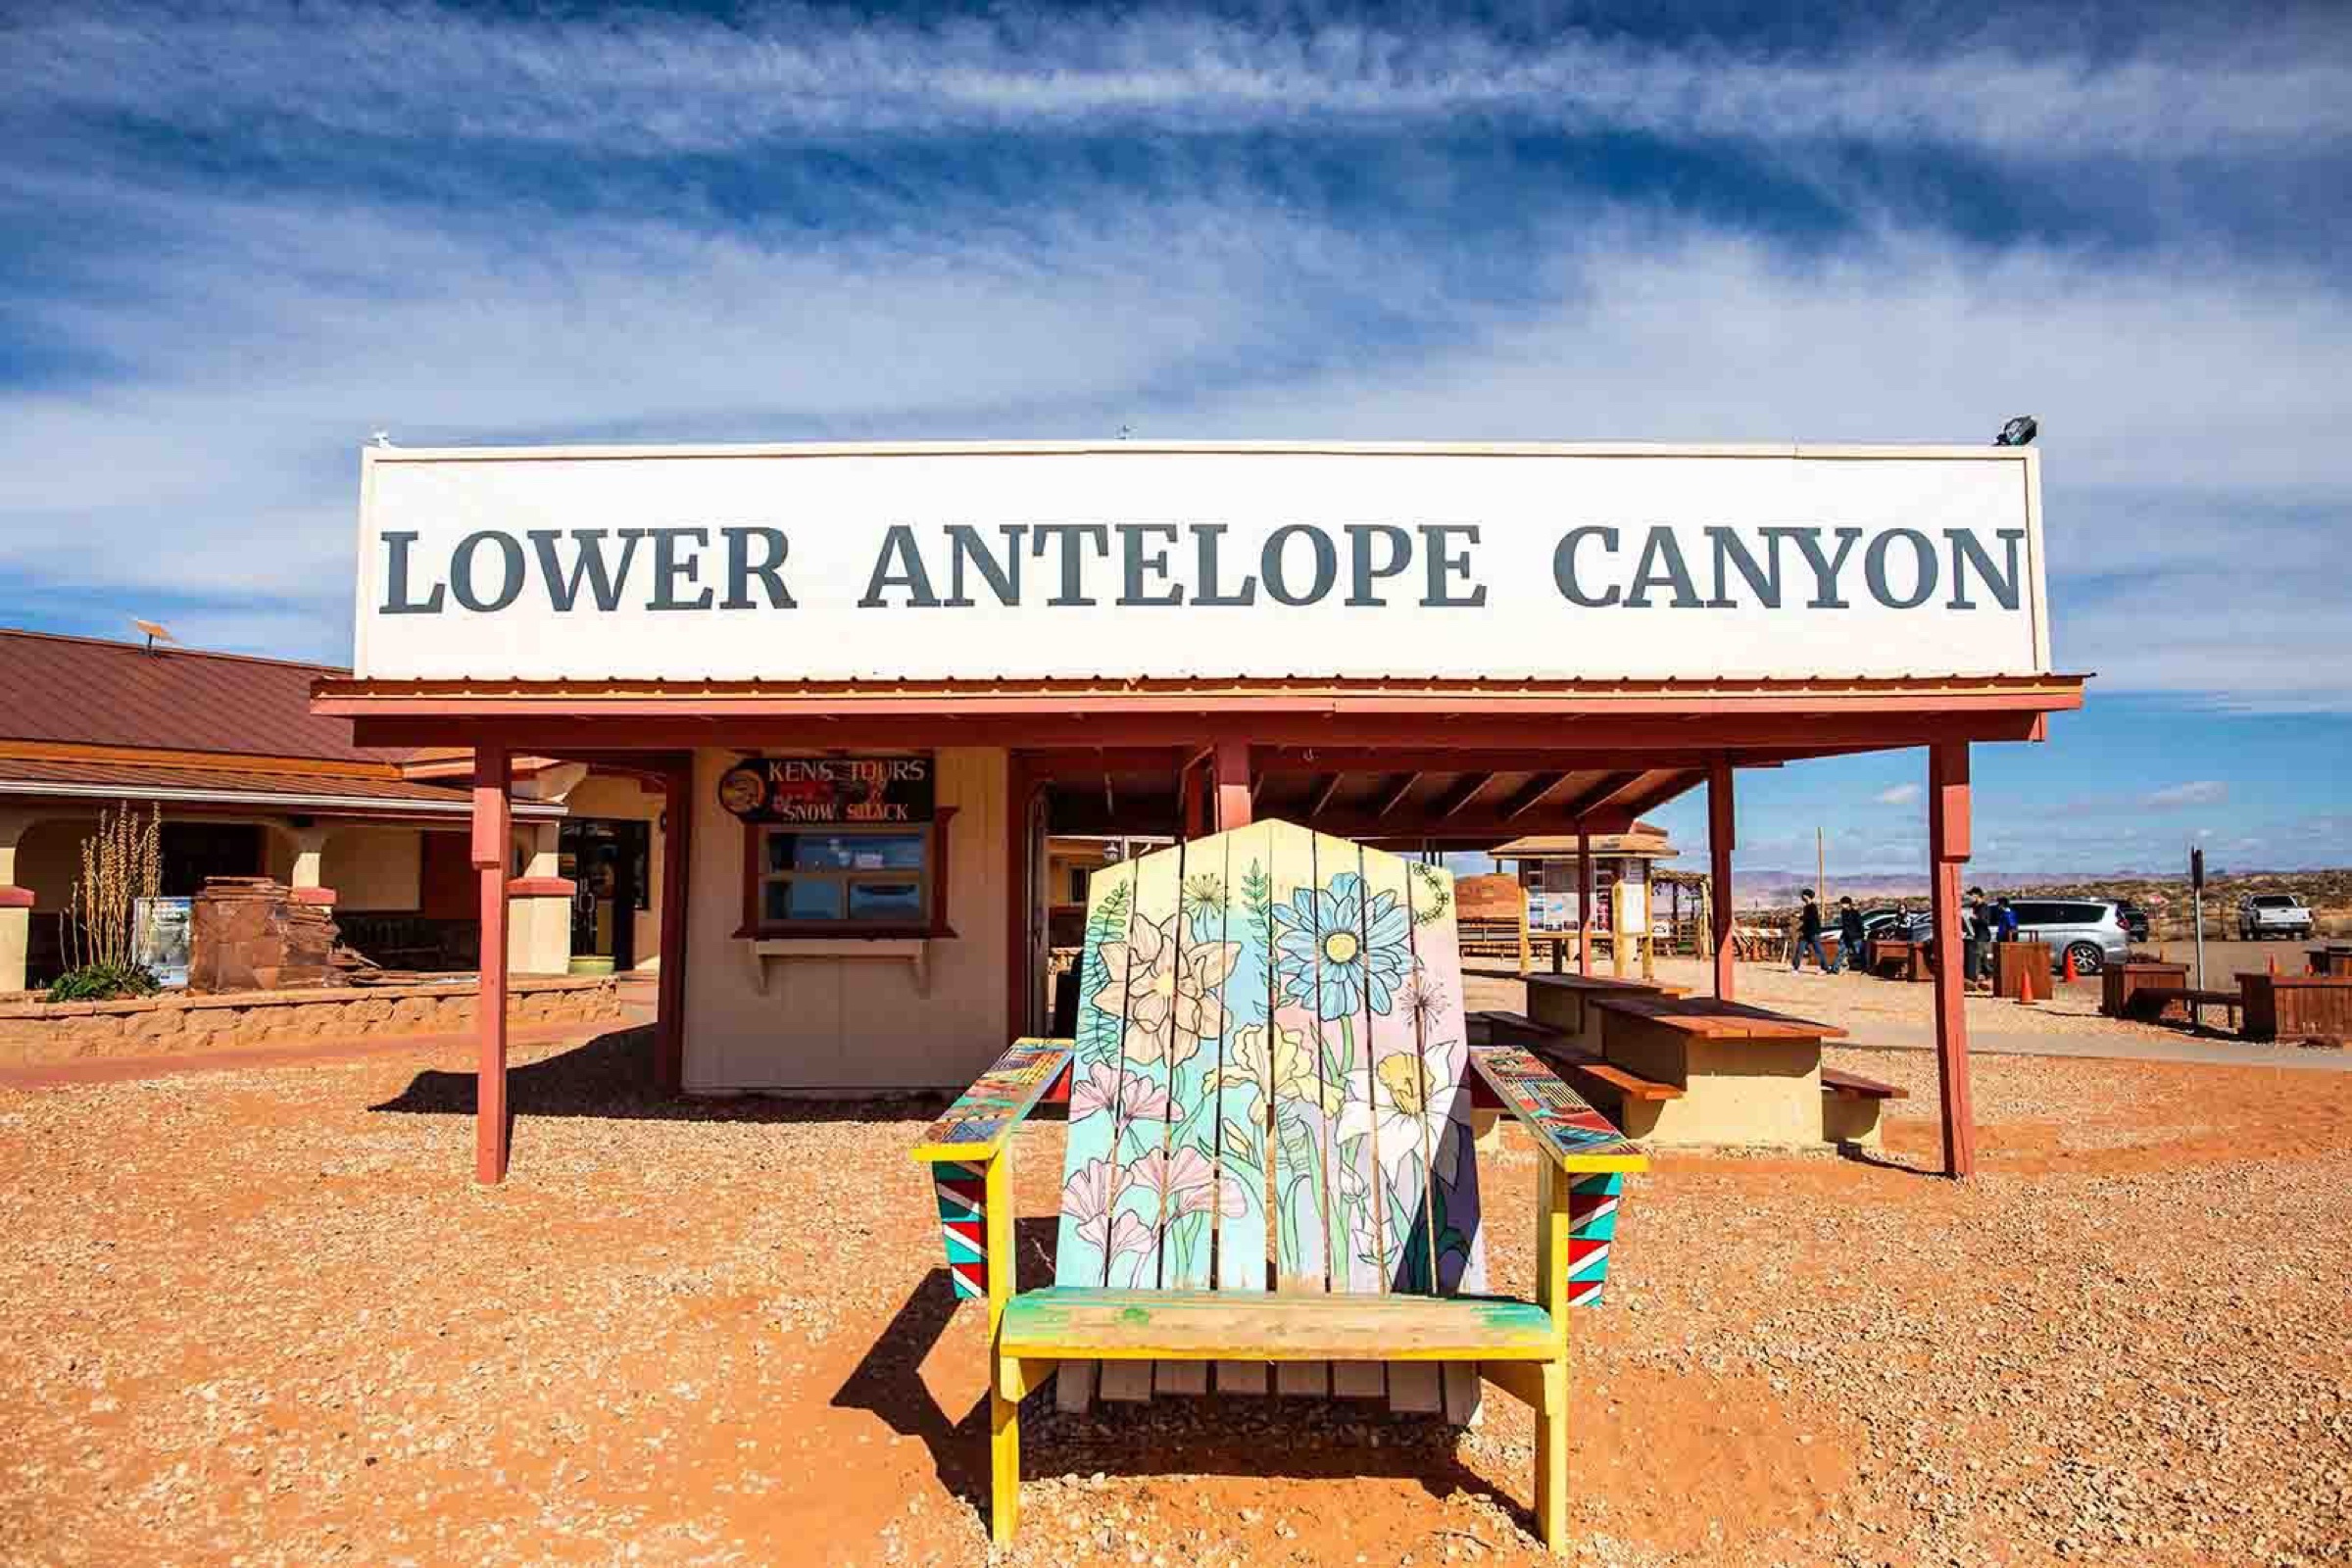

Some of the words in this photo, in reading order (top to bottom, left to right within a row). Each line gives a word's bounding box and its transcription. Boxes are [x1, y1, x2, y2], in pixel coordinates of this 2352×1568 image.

[378, 527, 798, 614] LOWER
[857, 523, 1487, 609] ANTELOPE
[1552, 523, 2025, 611] CANYON
[850, 760, 926, 782] TOURS
[783, 803, 838, 821] SNOW
[846, 803, 908, 821] SHACK
